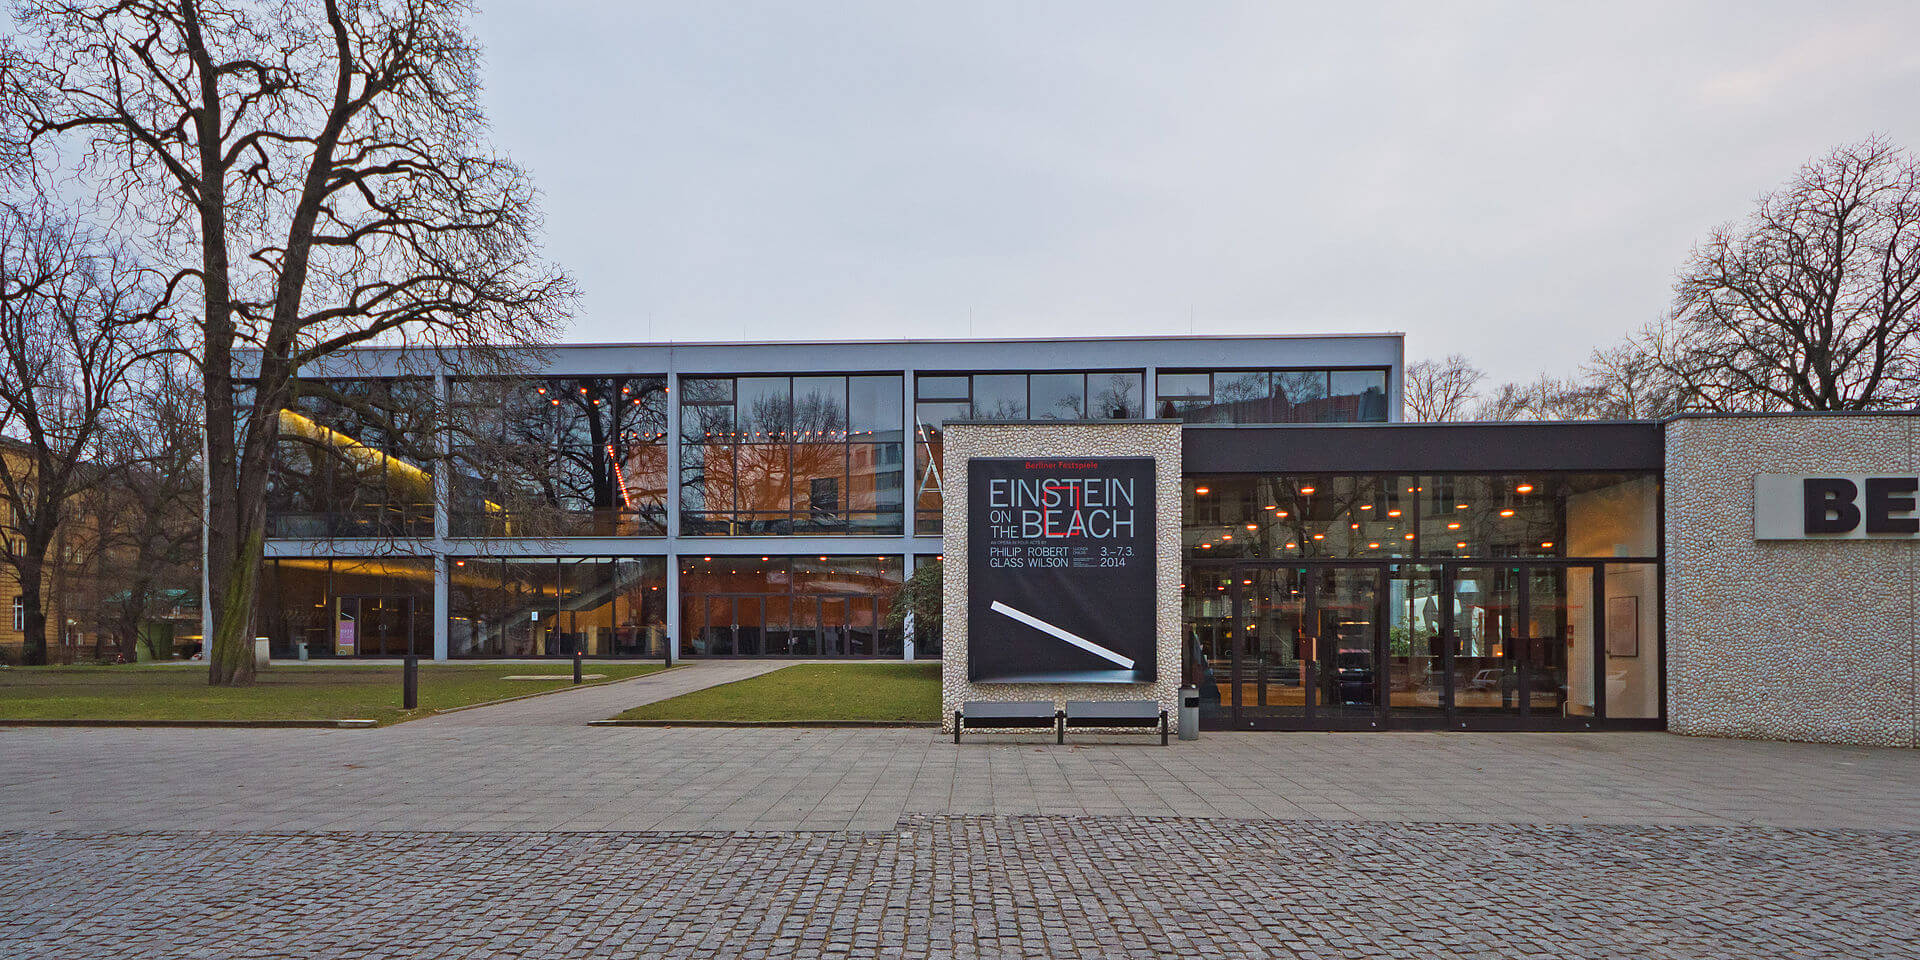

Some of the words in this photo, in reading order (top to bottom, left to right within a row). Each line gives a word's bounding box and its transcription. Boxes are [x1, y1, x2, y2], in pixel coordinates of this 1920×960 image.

[1025, 461, 1056, 469] Berliner
[1058, 461, 1098, 470] Festspiele
[990, 478, 1134, 507] EINSTEIN
[1803, 477, 1920, 534] BE
[990, 510, 1012, 523] ON
[1022, 509, 1134, 539] BEACH
[990, 525, 1019, 539] THE
[990, 547, 1021, 557] PHILIP
[1027, 547, 1069, 557] ROBERT
[990, 557, 1024, 568] GLASS
[1027, 557, 1069, 568] WILSON
[1100, 557, 1126, 568] 2014
